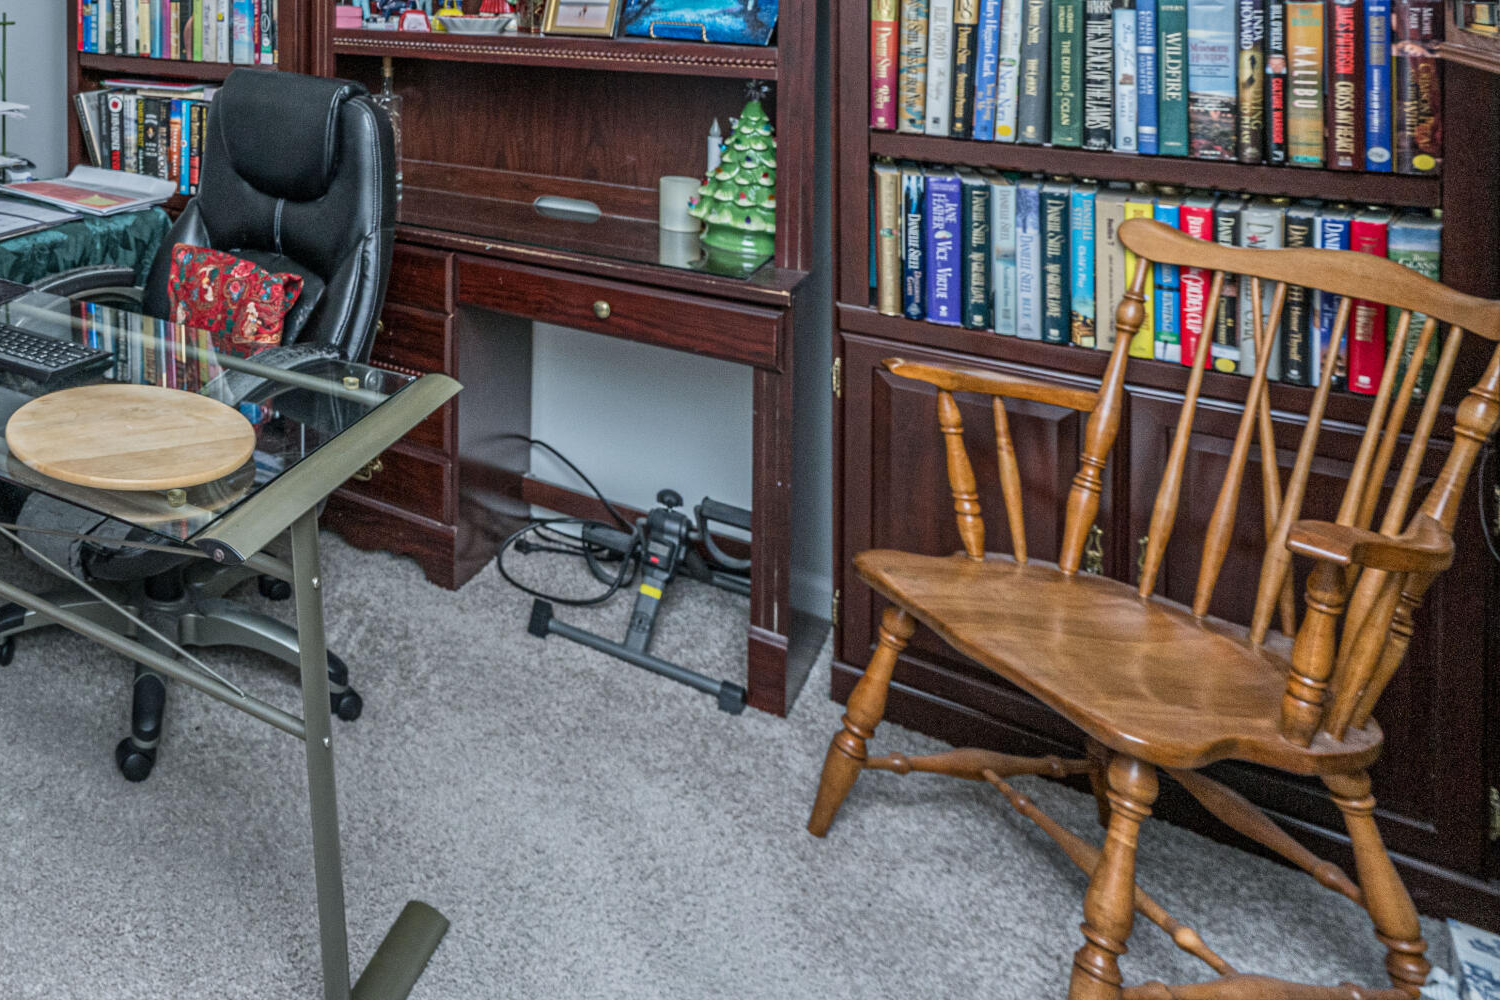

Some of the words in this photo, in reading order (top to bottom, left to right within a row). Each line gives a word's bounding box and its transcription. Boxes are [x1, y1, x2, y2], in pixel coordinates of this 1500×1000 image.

[1240, 1, 1253, 51] HOWARD
[1253, 9, 1264, 41] LINDA
[1271, 4, 1283, 19] BILL
[1335, 5, 1354, 31] JAMES
[1409, 7, 1419, 29] FABER
[983, 19, 997, 53] Higgins
[1086, 18, 1112, 36] THE
[1145, 10, 1154, 44] CHARLES
[1271, 20, 1283, 51] O'REILLY
[1061, 40, 1071, 55] THE
[1086, 37, 1112, 70] SILENCE
[1335, 32, 1354, 74] PATTERSON
[982, 53, 996, 78] Clark
[1061, 56, 1071, 74] DEEP
[1086, 70, 1112, 80] OF
[1146, 55, 1154, 95] AMERICAN
[1165, 32, 1182, 101] WILDFIRE
[1292, 45, 1318, 109] MALIBU
[1061, 75, 1071, 92] END
[1086, 81, 1112, 101] THE
[1271, 77, 1283, 109] CULTURE
[1335, 81, 1355, 109] CROSS
[1418, 63, 1431, 112] CRIMSON
[1061, 97, 1071, 126] OCEAN
[1086, 101, 1112, 130] LAMBS
[1251, 87, 1263, 130] DYING
[1335, 110, 1354, 124] MY
[1271, 110, 1283, 144] WARRIOR
[1335, 125, 1355, 154] HEART
[931, 193, 948, 230] FEATHER
[945, 203, 958, 224] JANE
[999, 189, 1011, 221] DANIELLE
[1072, 207, 1083, 230] STEEL
[1082, 199, 1093, 240] DANIELLE
[907, 213, 921, 248] DANIELLE
[971, 223, 988, 247] STEEL
[999, 222, 1012, 241] STEEL
[1047, 232, 1065, 257] STEEL
[1218, 217, 1235, 247] DANIE
[907, 248, 922, 269] STEEL
[936, 241, 953, 261] VICE
[1020, 235, 1033, 270] DANIELLE
[1078, 245, 1088, 271] Child's
[936, 267, 953, 299] VIRTUE
[1020, 271, 1034, 293] STEEL
[1077, 275, 1087, 288] Play
[1181, 273, 1203, 312] GOLDEN
[1022, 297, 1032, 318] BLUE
[1291, 306, 1302, 331] Honor
[1186, 312, 1203, 334] CUP
[1289, 333, 1303, 362] Thyself
